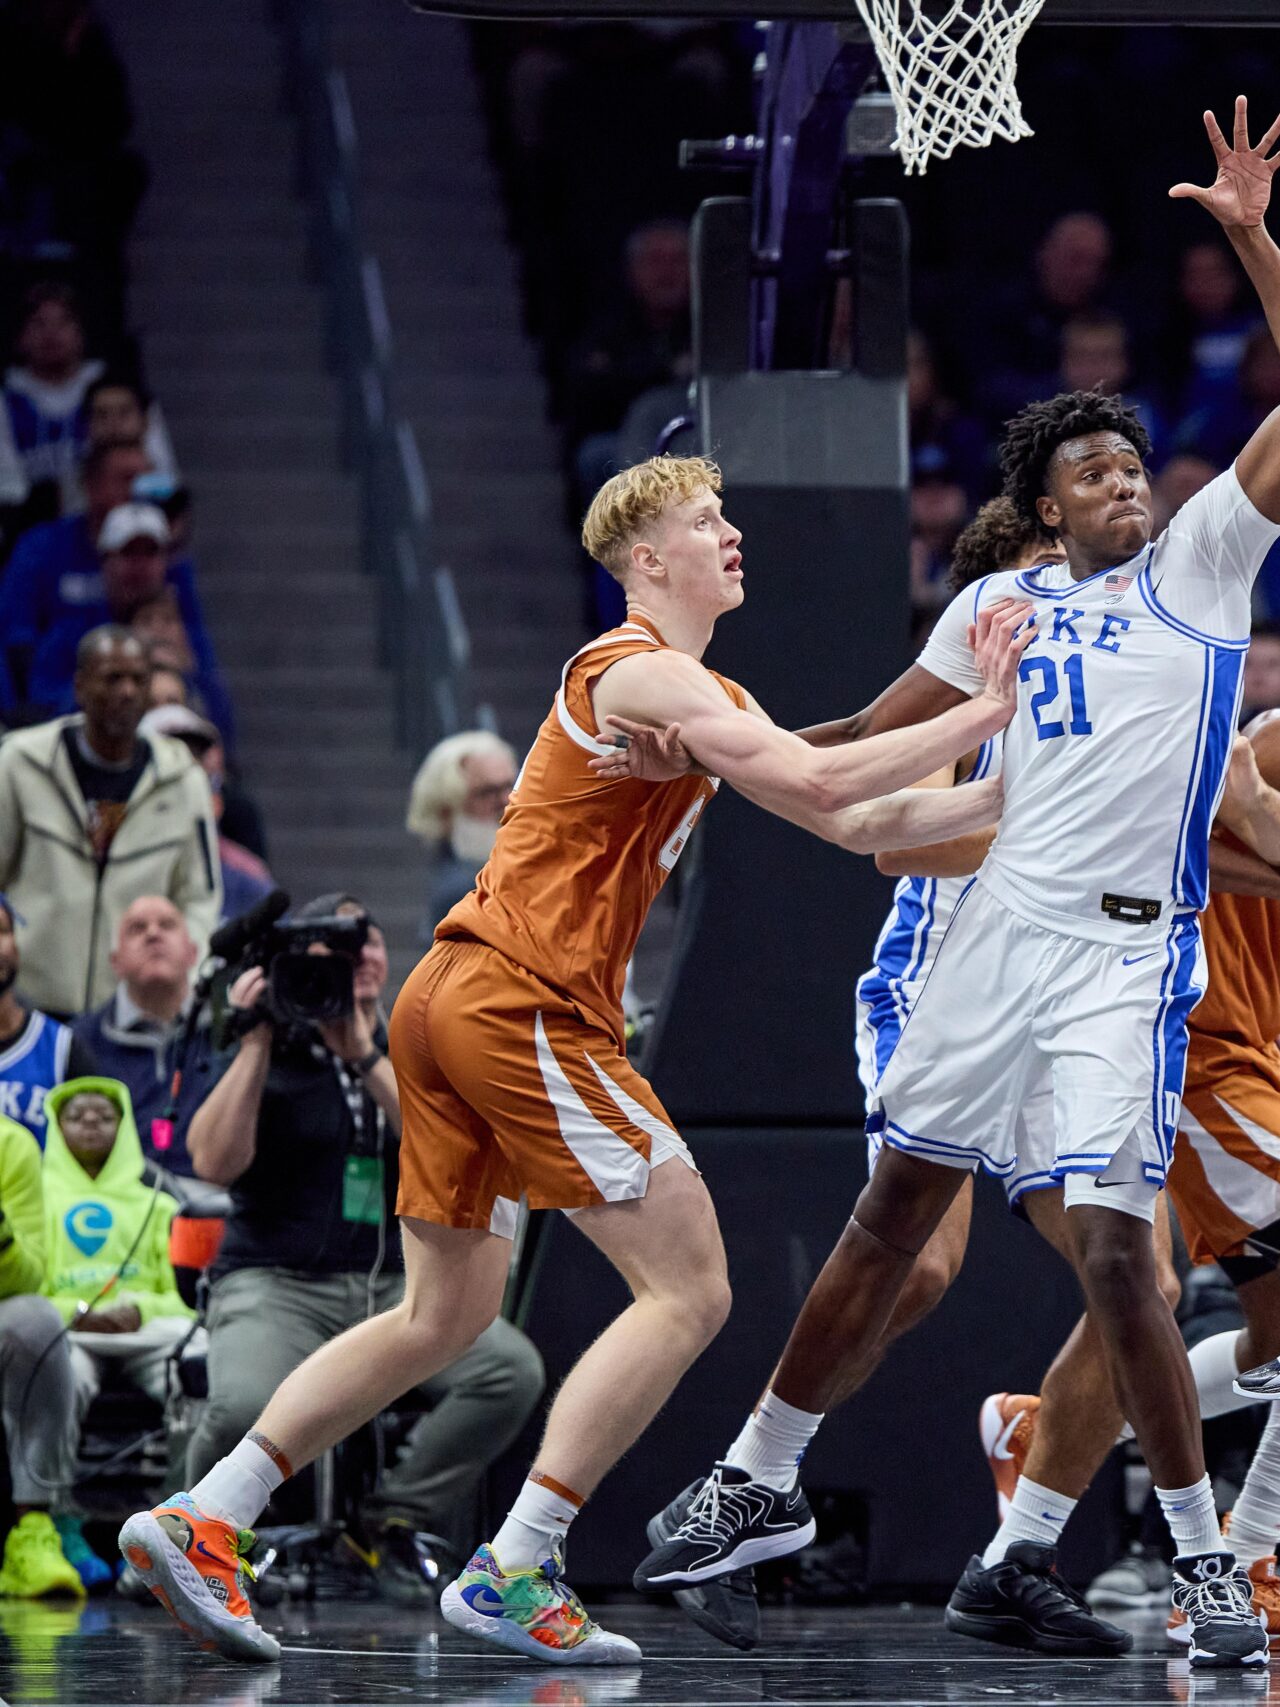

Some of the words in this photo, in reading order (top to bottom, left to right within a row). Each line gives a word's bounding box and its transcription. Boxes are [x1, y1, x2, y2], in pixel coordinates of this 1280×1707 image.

[1013, 607, 1131, 654] KE
[1018, 653, 1093, 742] 21
[1146, 904, 1158, 915] 52
